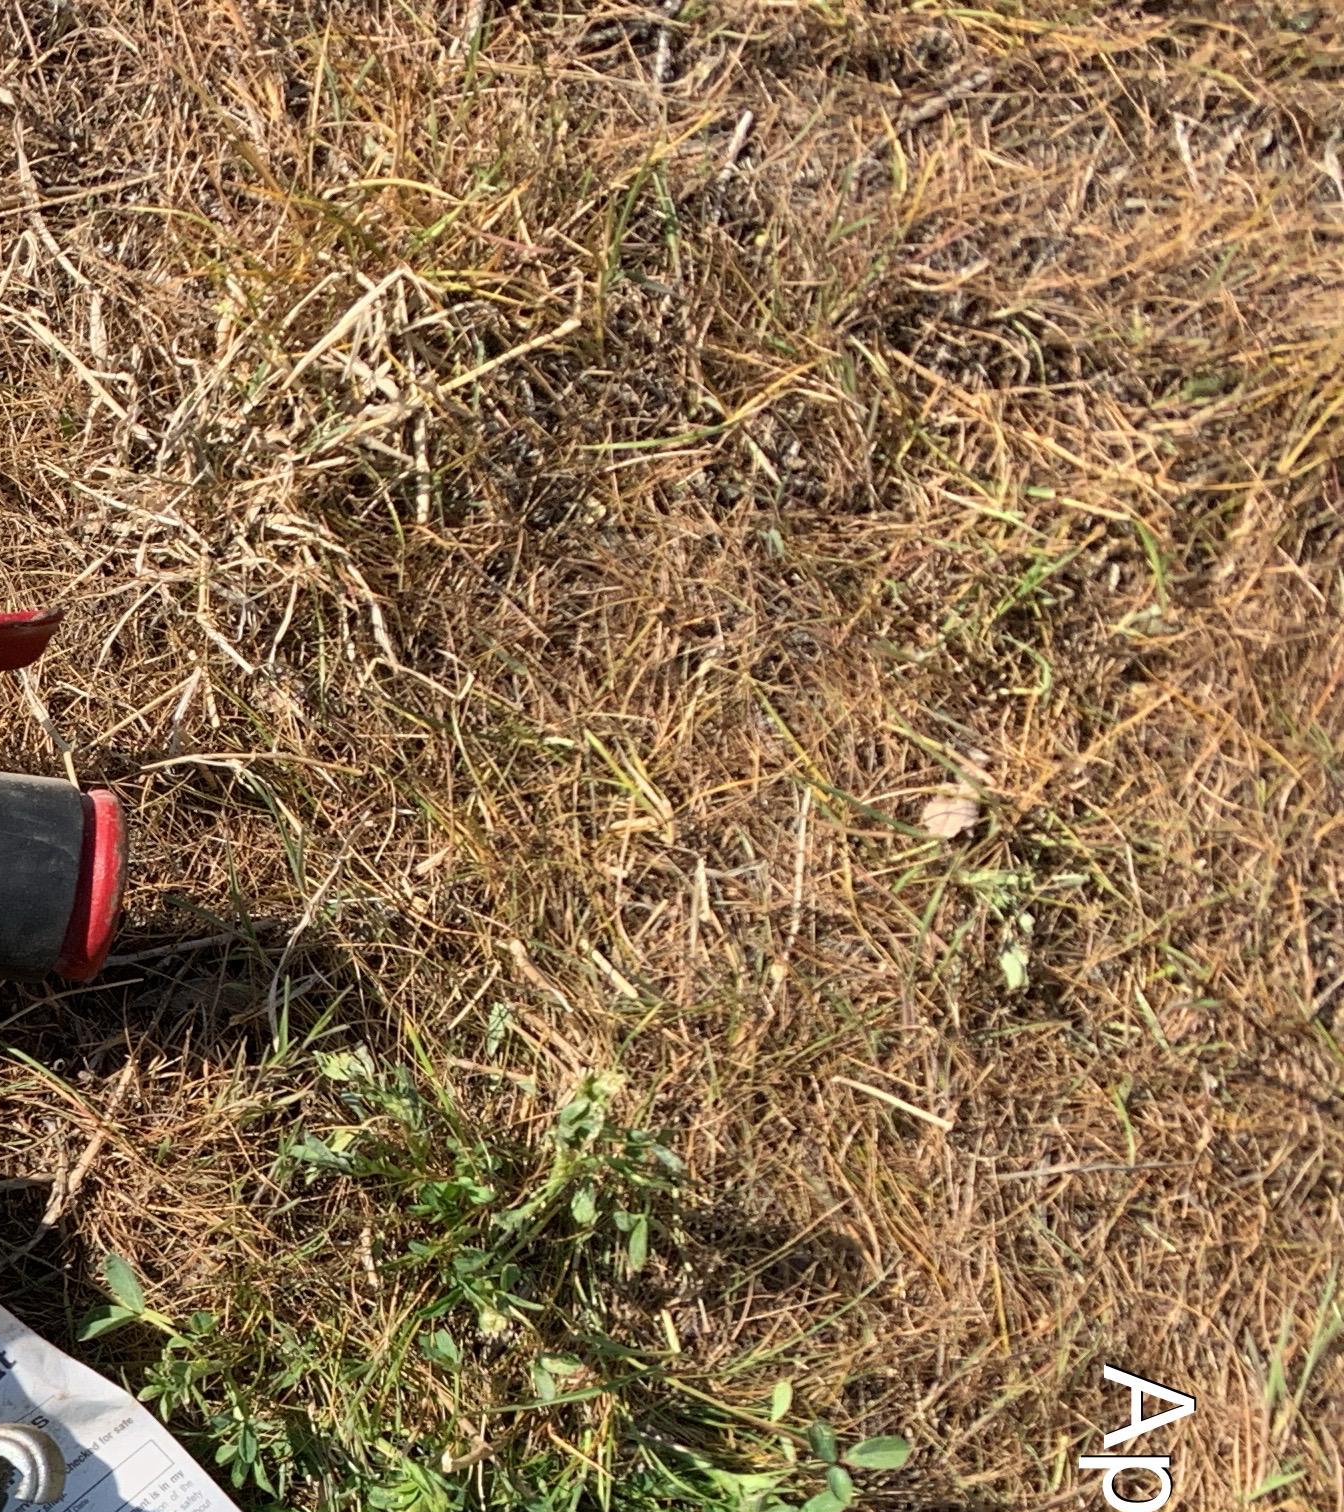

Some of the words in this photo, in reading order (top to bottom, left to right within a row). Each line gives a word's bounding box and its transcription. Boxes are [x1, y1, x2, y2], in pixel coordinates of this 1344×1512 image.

[97, 1431, 113, 1444] for
[113, 1417, 133, 1434] safe
[148, 1490, 160, 1500] is
[158, 1481, 170, 1492] in
[169, 1469, 184, 1483] my
[169, 1489, 180, 1502] of
[178, 1479, 194, 1492] the
[179, 1490, 203, 1510] safety
